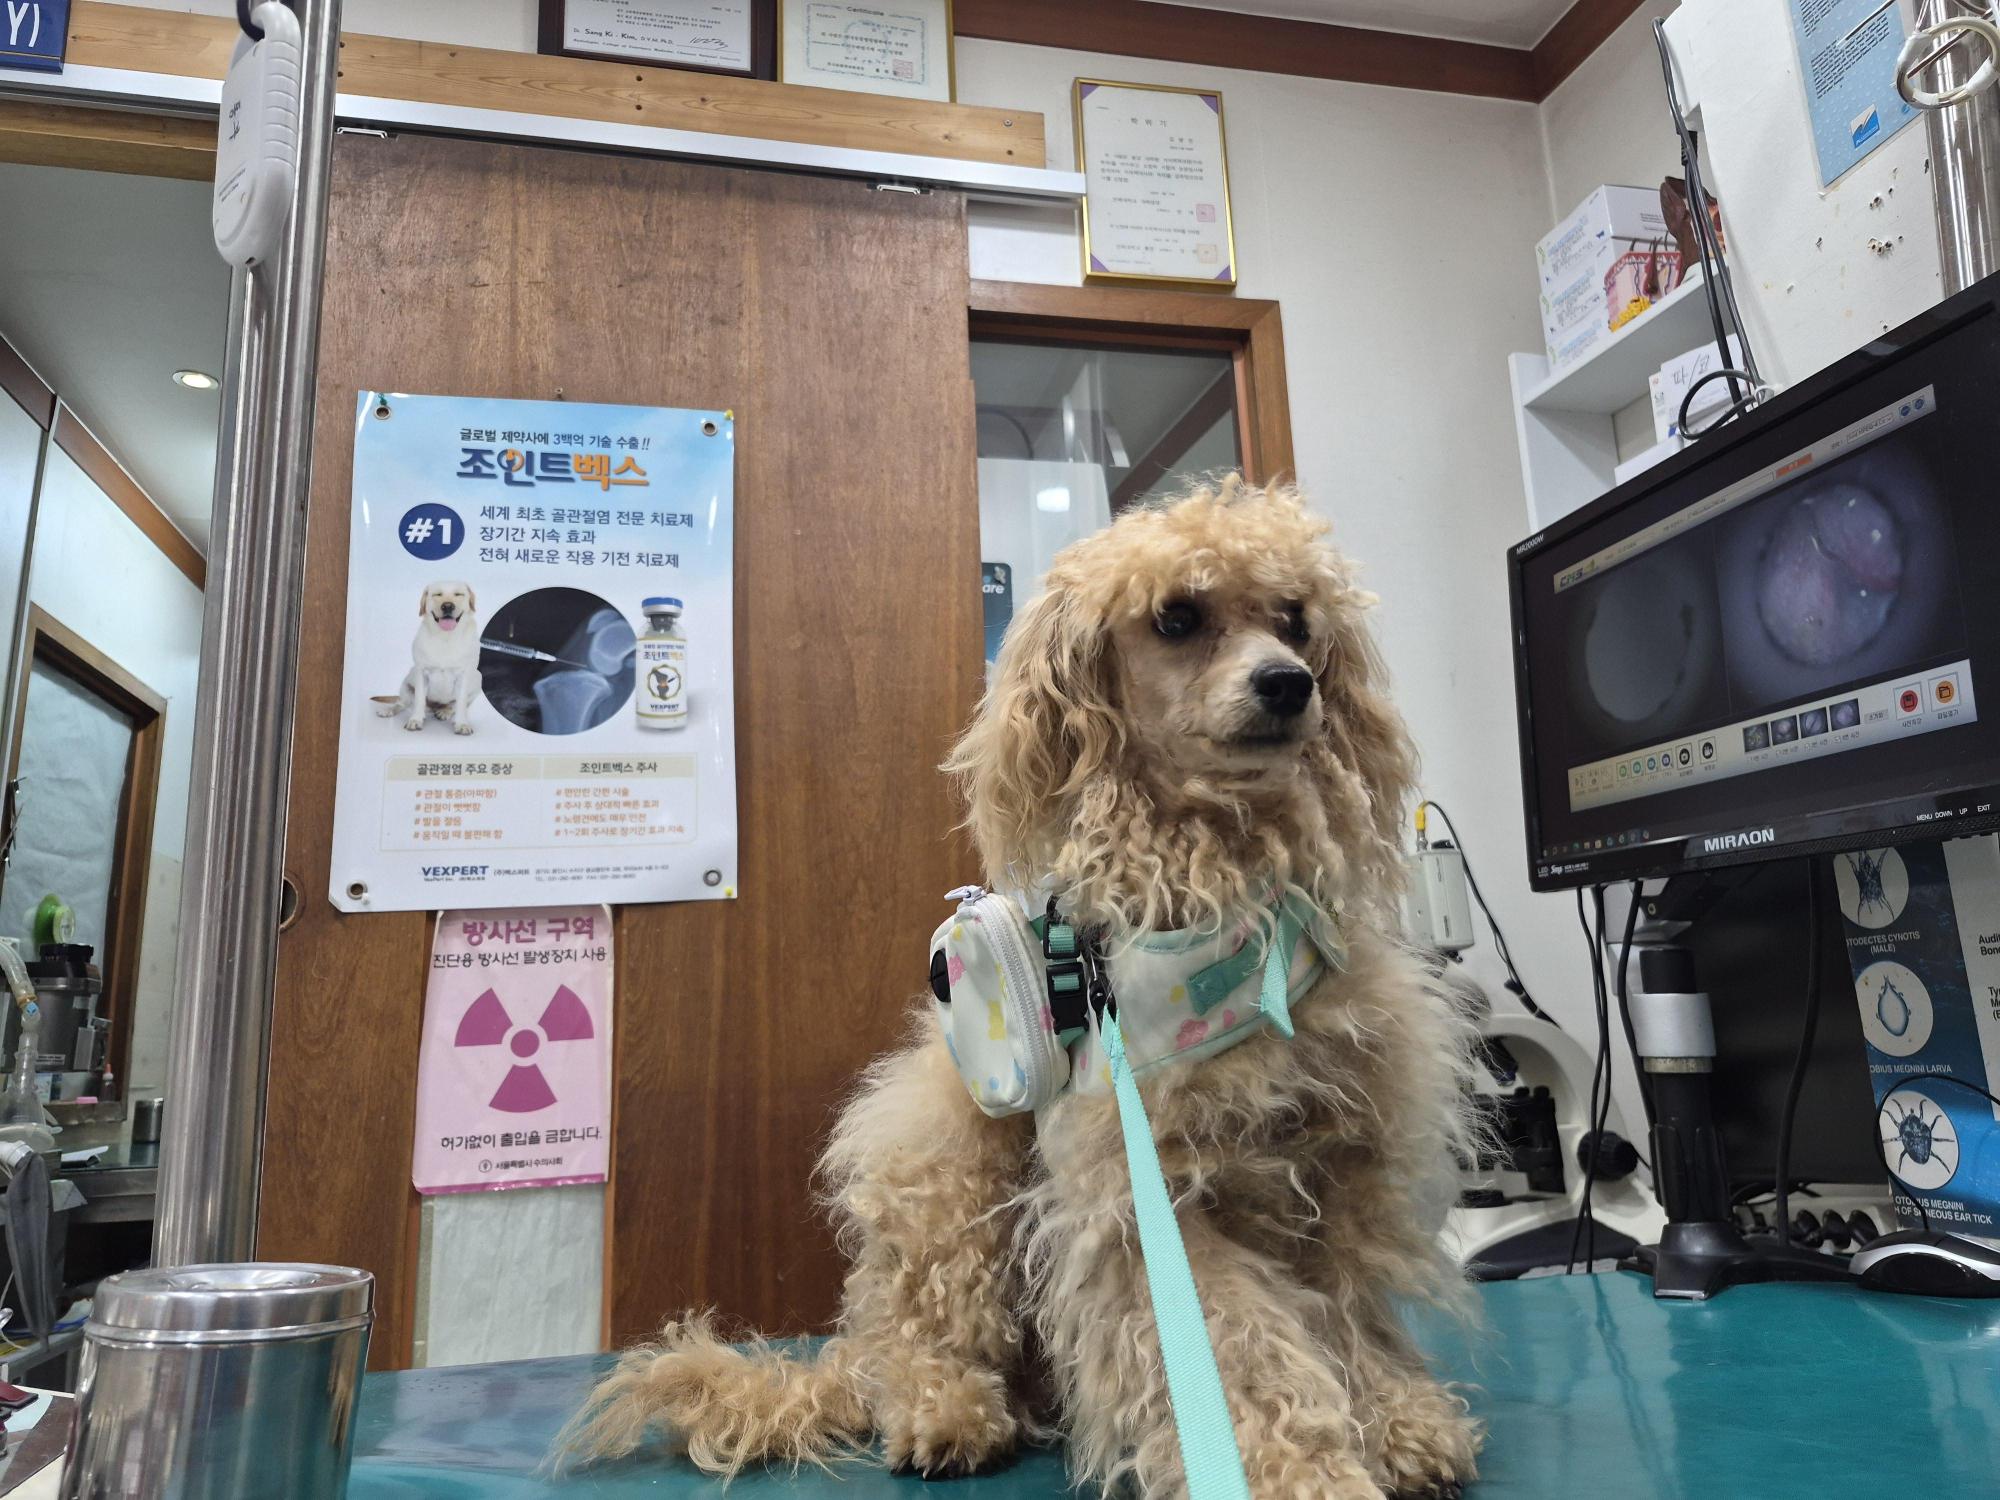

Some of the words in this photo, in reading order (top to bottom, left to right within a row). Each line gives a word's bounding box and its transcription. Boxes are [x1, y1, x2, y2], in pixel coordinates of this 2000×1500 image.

[8, 1, 40, 47] Y)
[585, 28, 602, 37] Sang
[460, 428, 496, 443] 글로벌
[501, 430, 549, 445] 제약사에
[553, 433, 584, 447] 3백억
[589, 434, 612, 449] 기술
[456, 448, 650, 492] 조인트벡스
[480, 505, 510, 521] 세계
[517, 506, 546, 521] 최초
[552, 508, 610, 525] 골관절염
[616, 510, 645, 526] 전문
[651, 512, 693, 528] 치료제
[405, 517, 452, 544] #1
[480, 526, 525, 542] 장기간
[531, 528, 561, 543] 지속
[566, 530, 597, 544] 효과
[480, 548, 509, 563] 전혀
[515, 549, 560, 564] 새로운
[566, 550, 595, 566] 작용
[602, 552, 630, 566] 기전
[636, 553, 680, 568] 치료제
[417, 763, 462, 776] 골관절염
[465, 763, 488, 775] 주요
[491, 763, 514, 775] 증상
[580, 762, 634, 774] 조인트벡스
[636, 762, 658, 774] 주사
[1935, 810, 1952, 818] DOWN
[1977, 804, 1991, 812] EXIT
[1704, 828, 1775, 852] MIRAON
[421, 866, 489, 876] VEXPERT
[462, 918, 536, 947] 방사선
[547, 916, 594, 942] 구역
[433, 952, 474, 968] 진단용
[478, 951, 519, 967] 방사선
[523, 948, 577, 964] 발생장치
[582, 946, 607, 962] 사용
[1870, 944, 1896, 954] (MALE)
[1926, 1064, 1952, 1073] LARVA
[441, 1134, 496, 1150] 허가없이
[500, 1130, 541, 1147] 출입을
[545, 1127, 602, 1144] 금합니다.
[495, 1160, 532, 1169] 서울특별시
[534, 1157, 563, 1167] 수의사회
[1930, 1200, 1964, 1211] MEGNINI
[1913, 1208, 1953, 1220] SNEOUS
[1954, 1212, 1971, 1222] EAR
[1972, 1214, 1992, 1224] TICK
